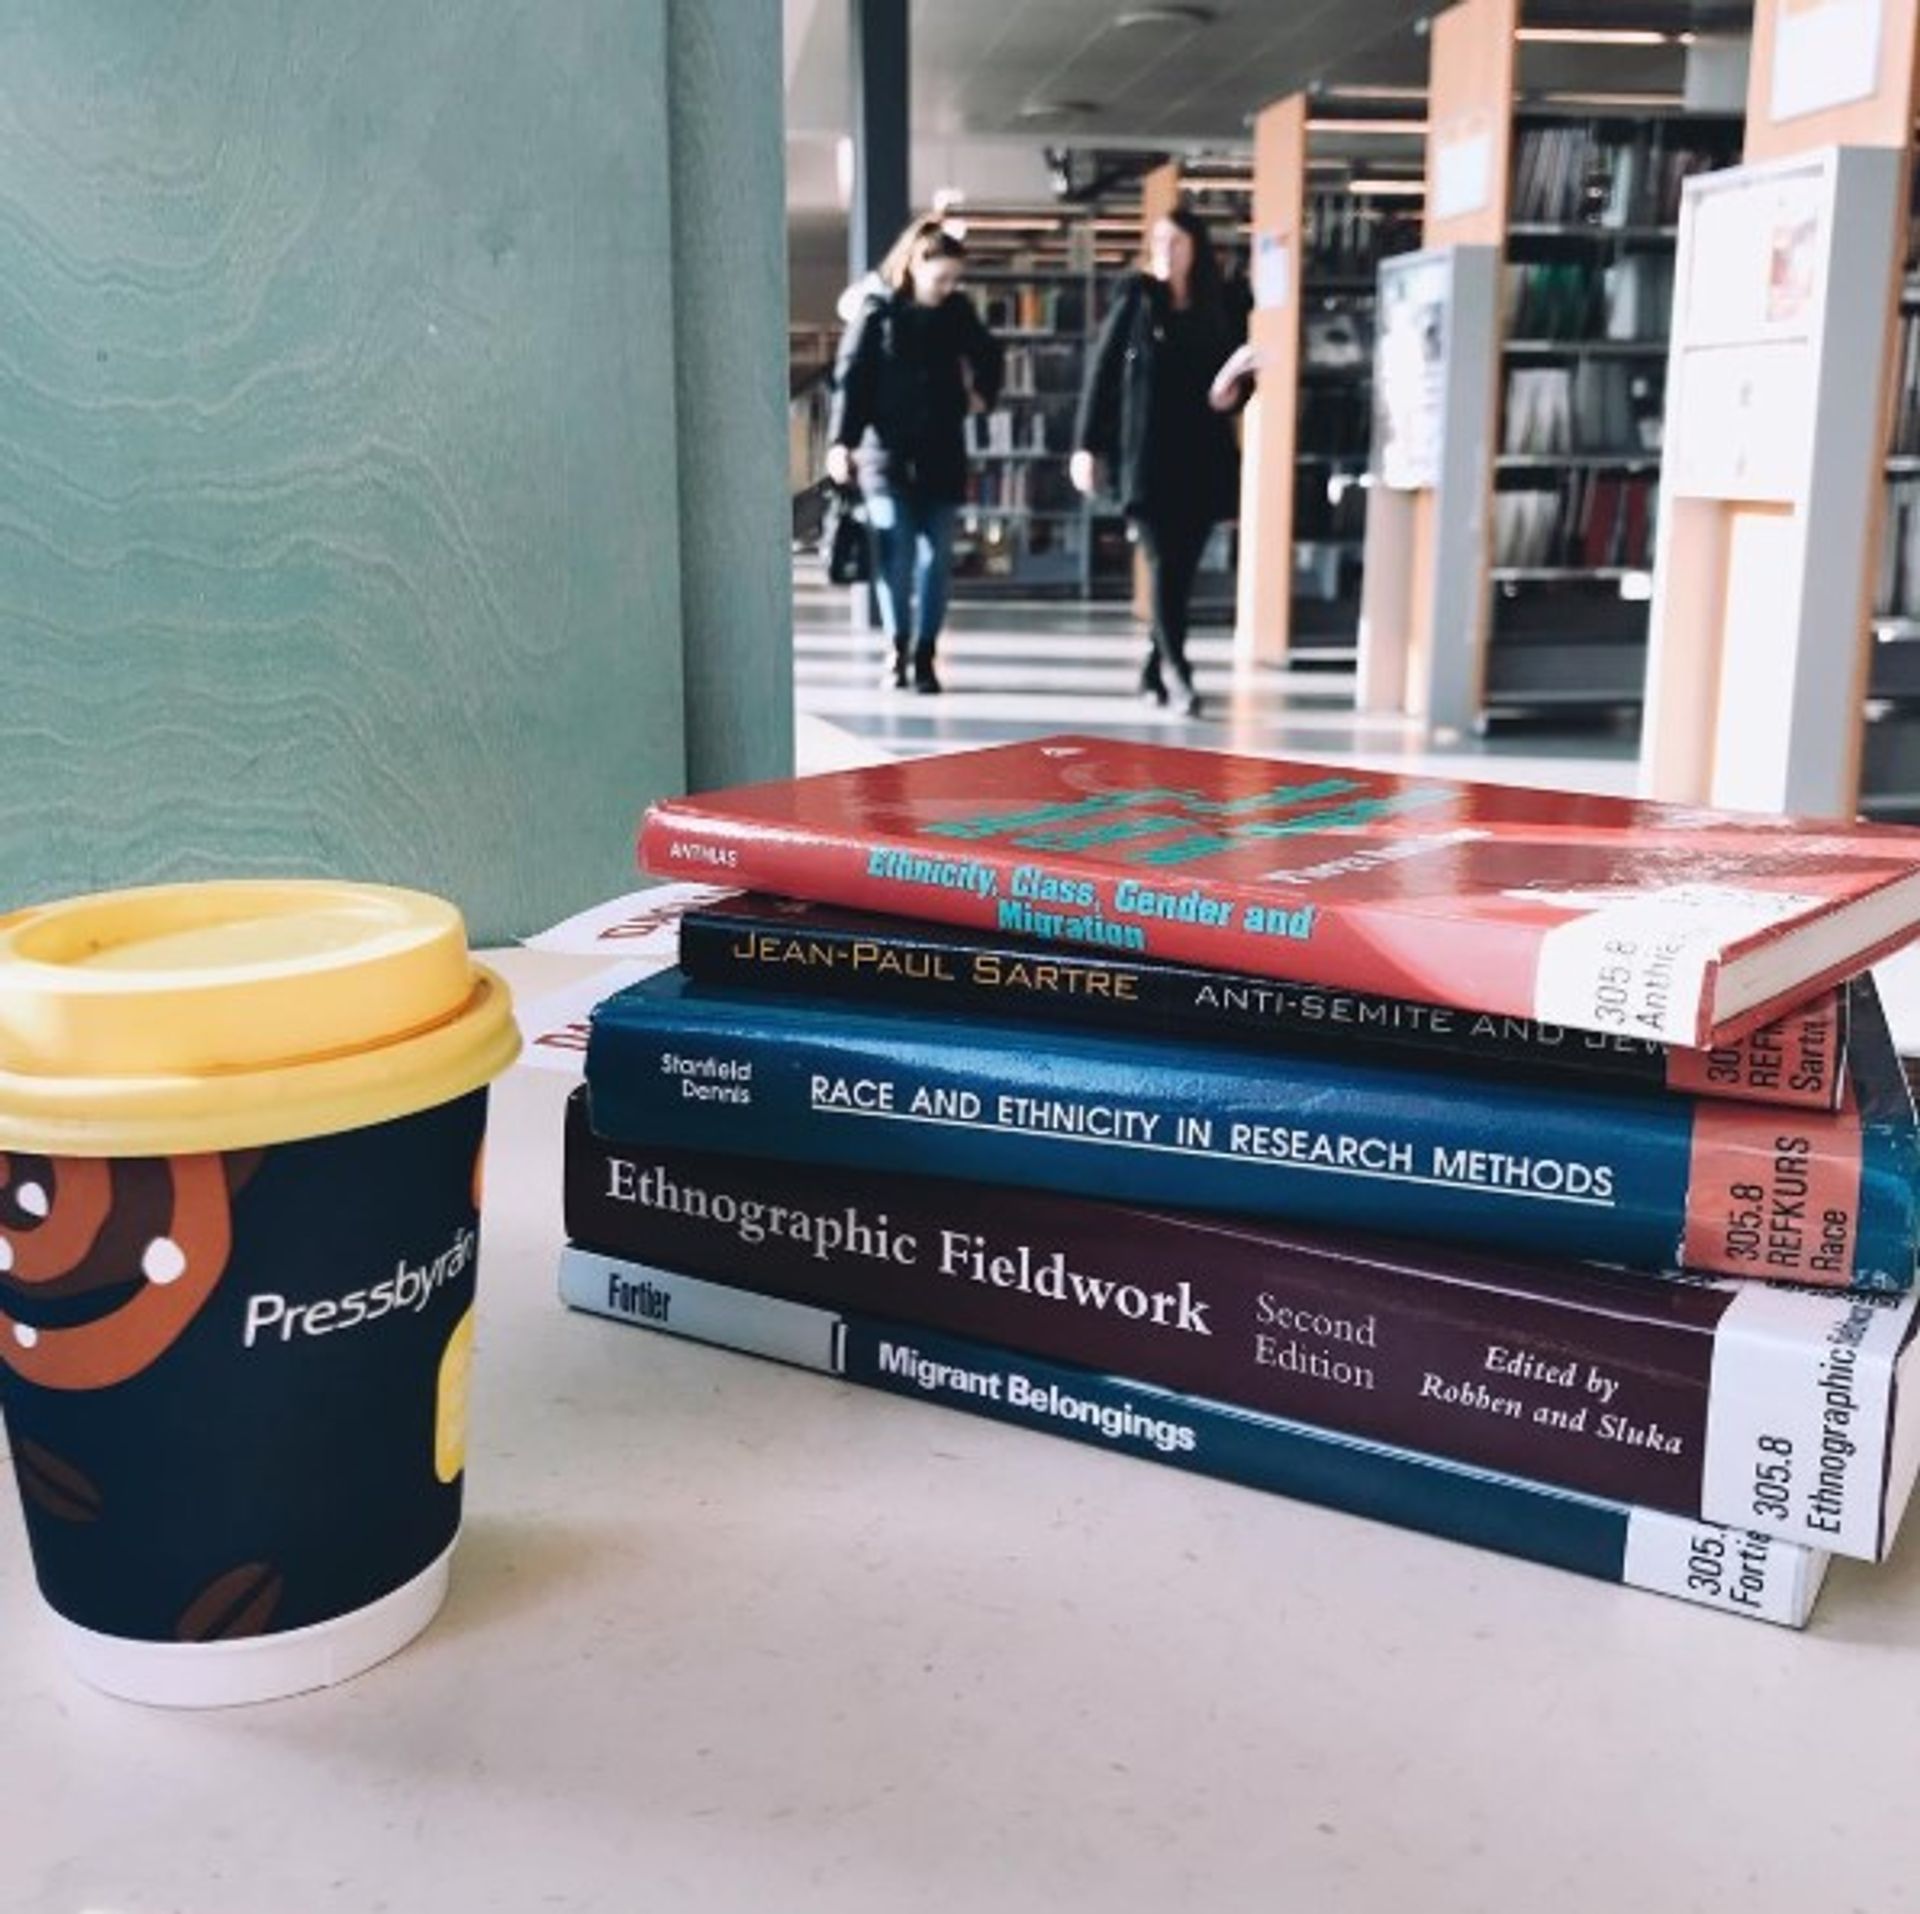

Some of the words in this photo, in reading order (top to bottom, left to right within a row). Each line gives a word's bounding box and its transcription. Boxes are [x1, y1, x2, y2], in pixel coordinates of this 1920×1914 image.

[669, 842, 737, 868] ANTHIAS
[867, 845, 998, 898] Ethnicity,
[1010, 865, 1100, 910] Class,
[1114, 880, 1234, 926] Gender
[1243, 903, 1315, 939] and
[998, 900, 1146, 949] Migration
[733, 931, 955, 979] JEAN-PAUL
[972, 954, 1139, 1001] SARTRE
[1195, 984, 1453, 1034] ANTI-SEMITE
[1470, 1014, 1565, 1046] AND
[660, 1052, 753, 1082] Stanfield
[681, 1079, 752, 1104] Dennis
[810, 1075, 896, 1112] RACE
[909, 1088, 981, 1120] AND
[997, 1096, 1160, 1142] ETHNICITY
[1176, 1117, 1213, 1149] IN
[1229, 1123, 1414, 1173] RESEARCH
[1432, 1146, 1616, 1197] METHODS
[1725, 1183, 1765, 1262] 305.8
[1765, 1136, 1811, 1268] REFKURS
[606, 1157, 919, 1266] Ethnographic
[939, 1230, 1213, 1336] Fieldwork
[1809, 1209, 1849, 1273] Race
[606, 1273, 672, 1324] Fortier
[1255, 1292, 1378, 1349] Second
[1253, 1333, 1376, 1391] Edition
[1484, 1345, 1578, 1389] Edited
[1587, 1364, 1620, 1403] by
[878, 1341, 1001, 1400] Migrant
[1007, 1376, 1197, 1451] Belongings
[1419, 1373, 1523, 1419] Robben
[1532, 1402, 1588, 1434] and
[1597, 1414, 1686, 1456] Sluka
[1806, 1347, 1860, 1535] Ethnographic
[1752, 1433, 1794, 1520] 305.8
[1687, 1533, 1727, 1597] 305.
